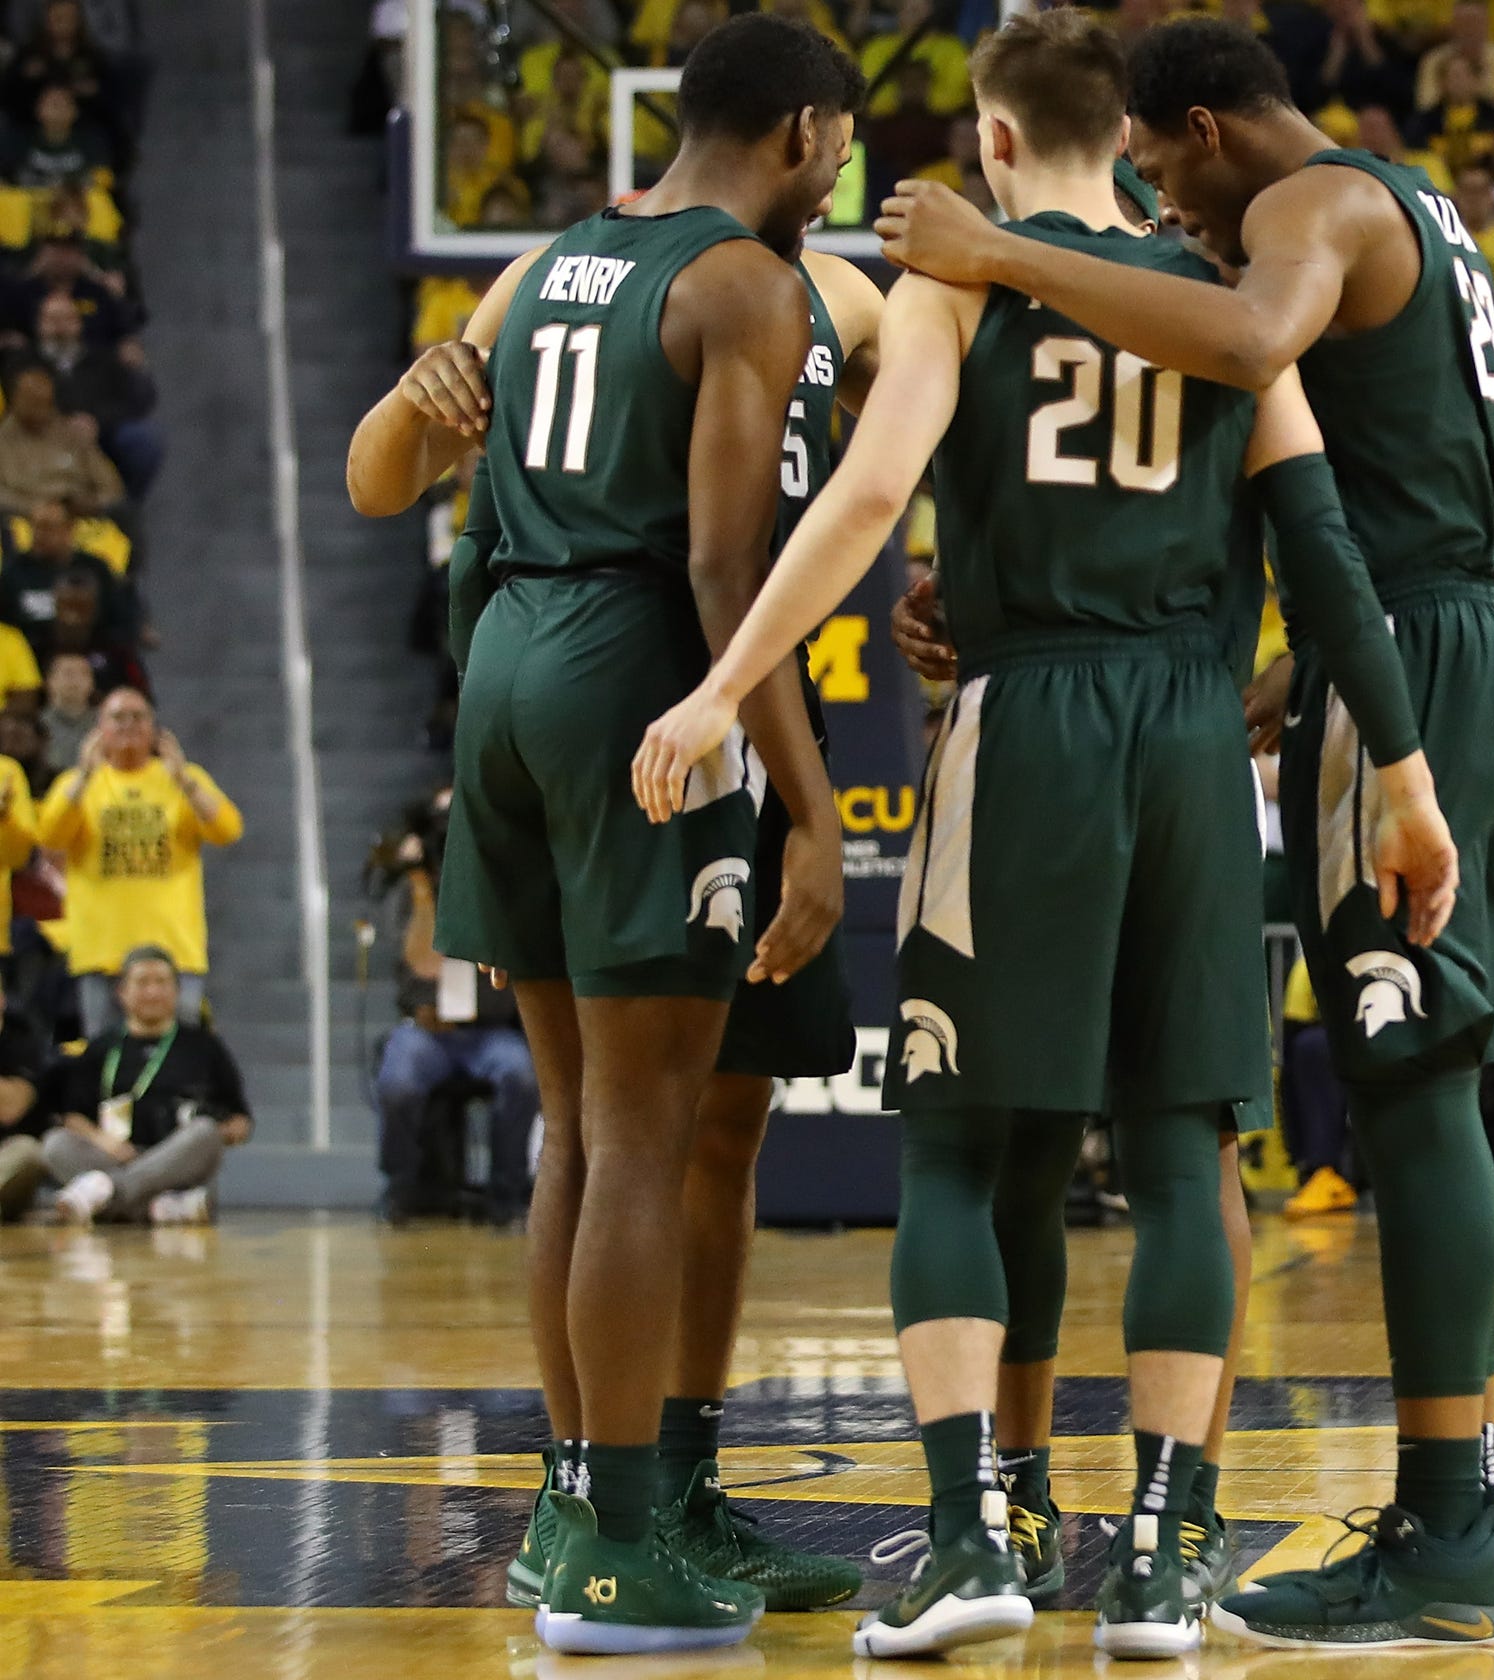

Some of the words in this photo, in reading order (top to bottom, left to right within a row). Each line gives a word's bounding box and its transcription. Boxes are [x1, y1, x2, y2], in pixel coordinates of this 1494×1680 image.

[539, 255, 636, 304] HENRY
[525, 322, 602, 474] 11
[1026, 335, 1184, 494] 20
[806, 614, 870, 703] M
[833, 785, 916, 833] CU
